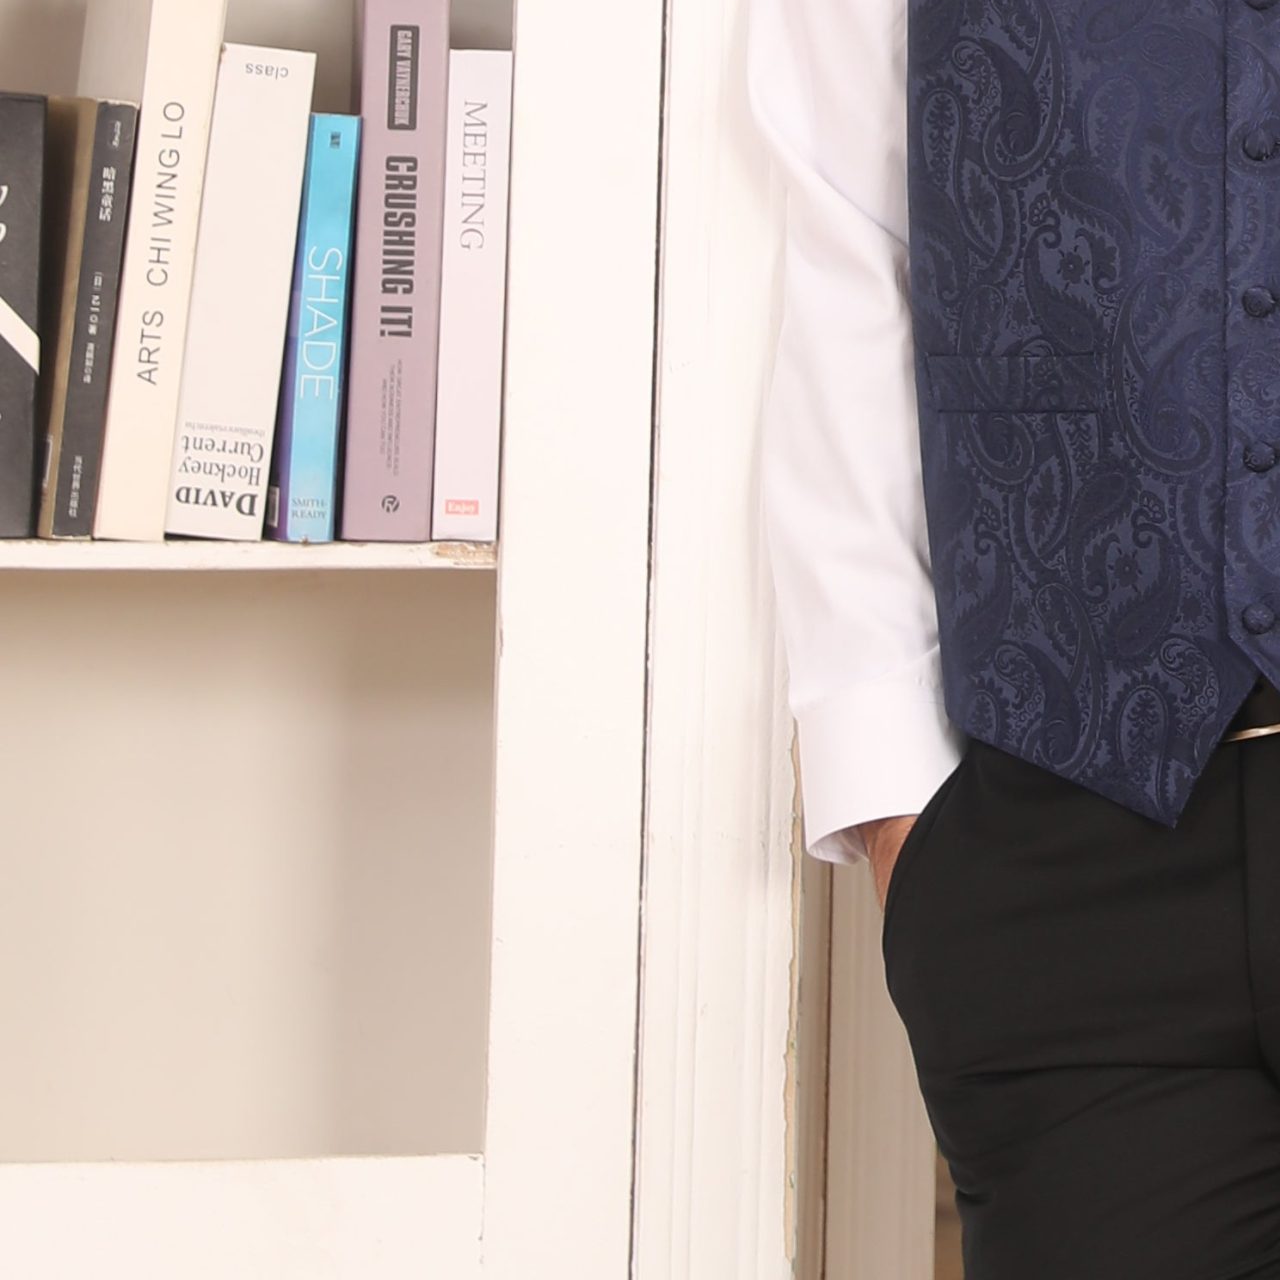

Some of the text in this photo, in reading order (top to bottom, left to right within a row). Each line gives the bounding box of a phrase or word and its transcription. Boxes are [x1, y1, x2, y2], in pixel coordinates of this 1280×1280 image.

[397, 29, 414, 60] GARY
[245, 62, 289, 80] class
[460, 100, 490, 251] MEETING
[380, 155, 419, 296] CRUSHING
[136, 101, 186, 387] ARTS CHI WING LO
[300, 245, 345, 401] SHADE
[378, 304, 414, 339] IT!
[181, 434, 265, 464] Current
[178, 456, 262, 486] Hockney
